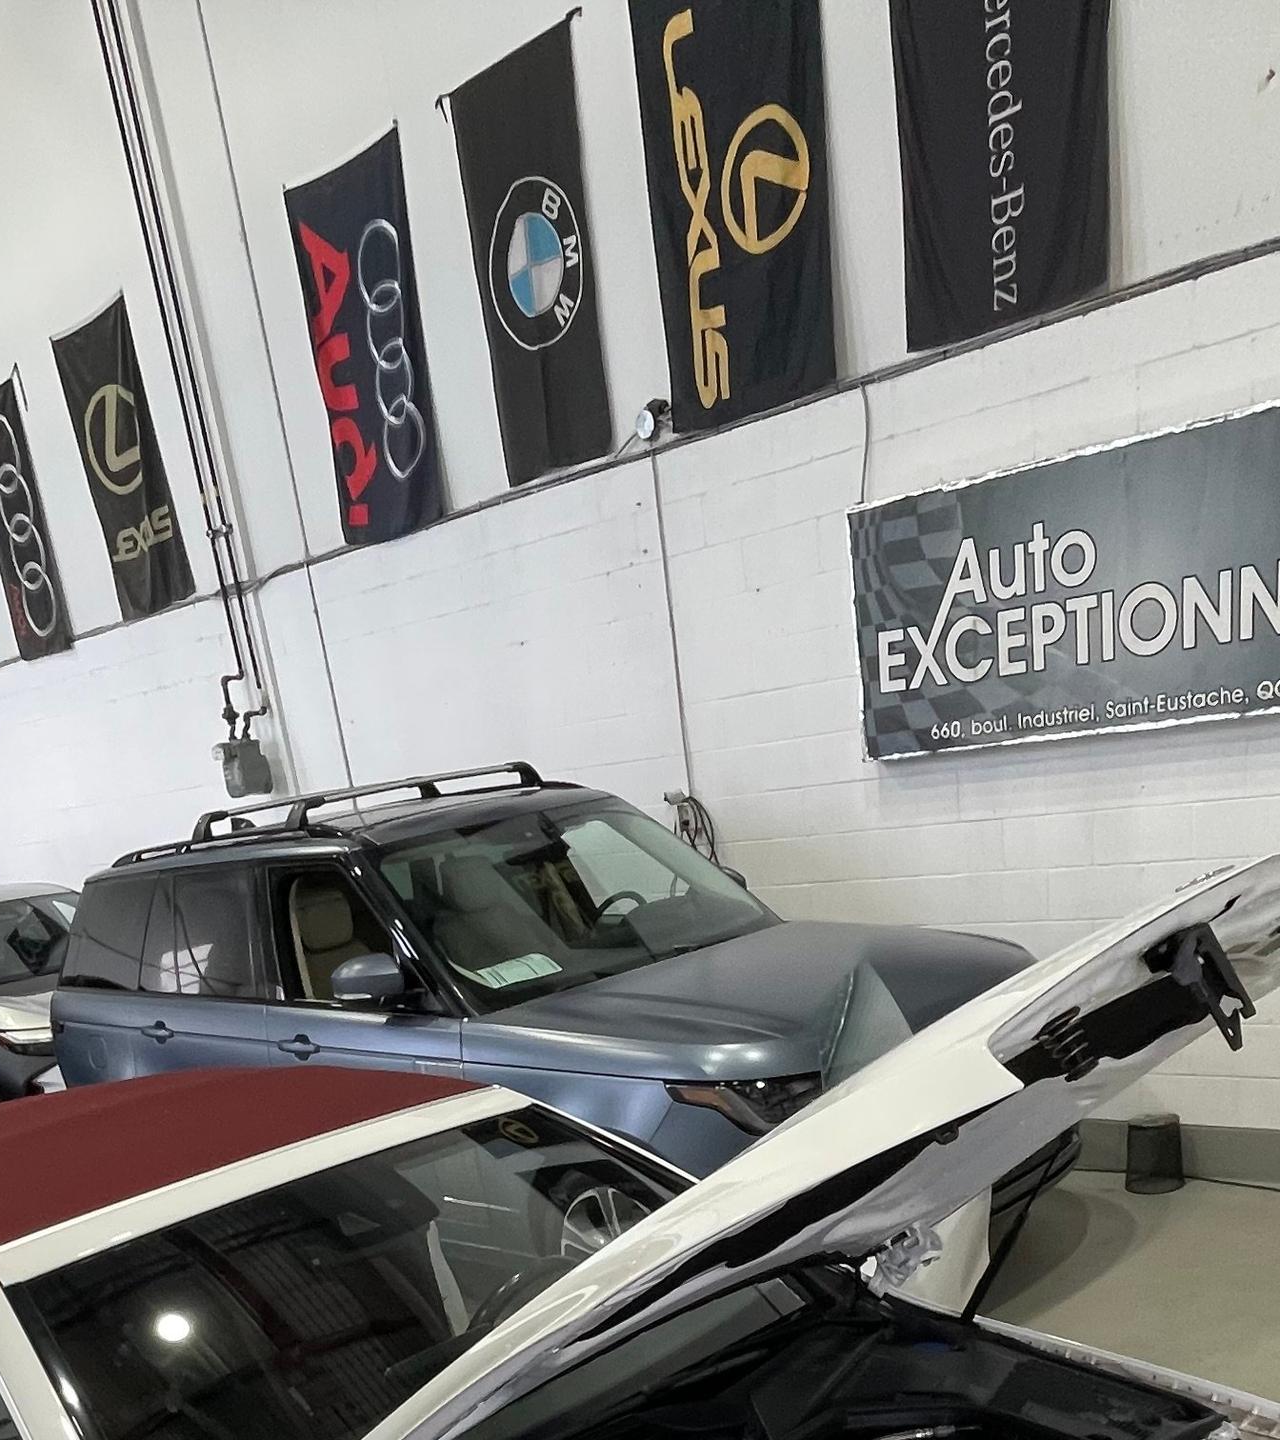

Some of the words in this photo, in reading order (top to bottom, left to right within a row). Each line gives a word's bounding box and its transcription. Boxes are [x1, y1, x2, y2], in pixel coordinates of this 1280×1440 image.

[541, 187, 580, 327] BMW
[663, 9, 730, 410] LEXUS
[946, 521, 1097, 604] Auto
[1106, 687, 1249, 719] Saint-Eustache,
